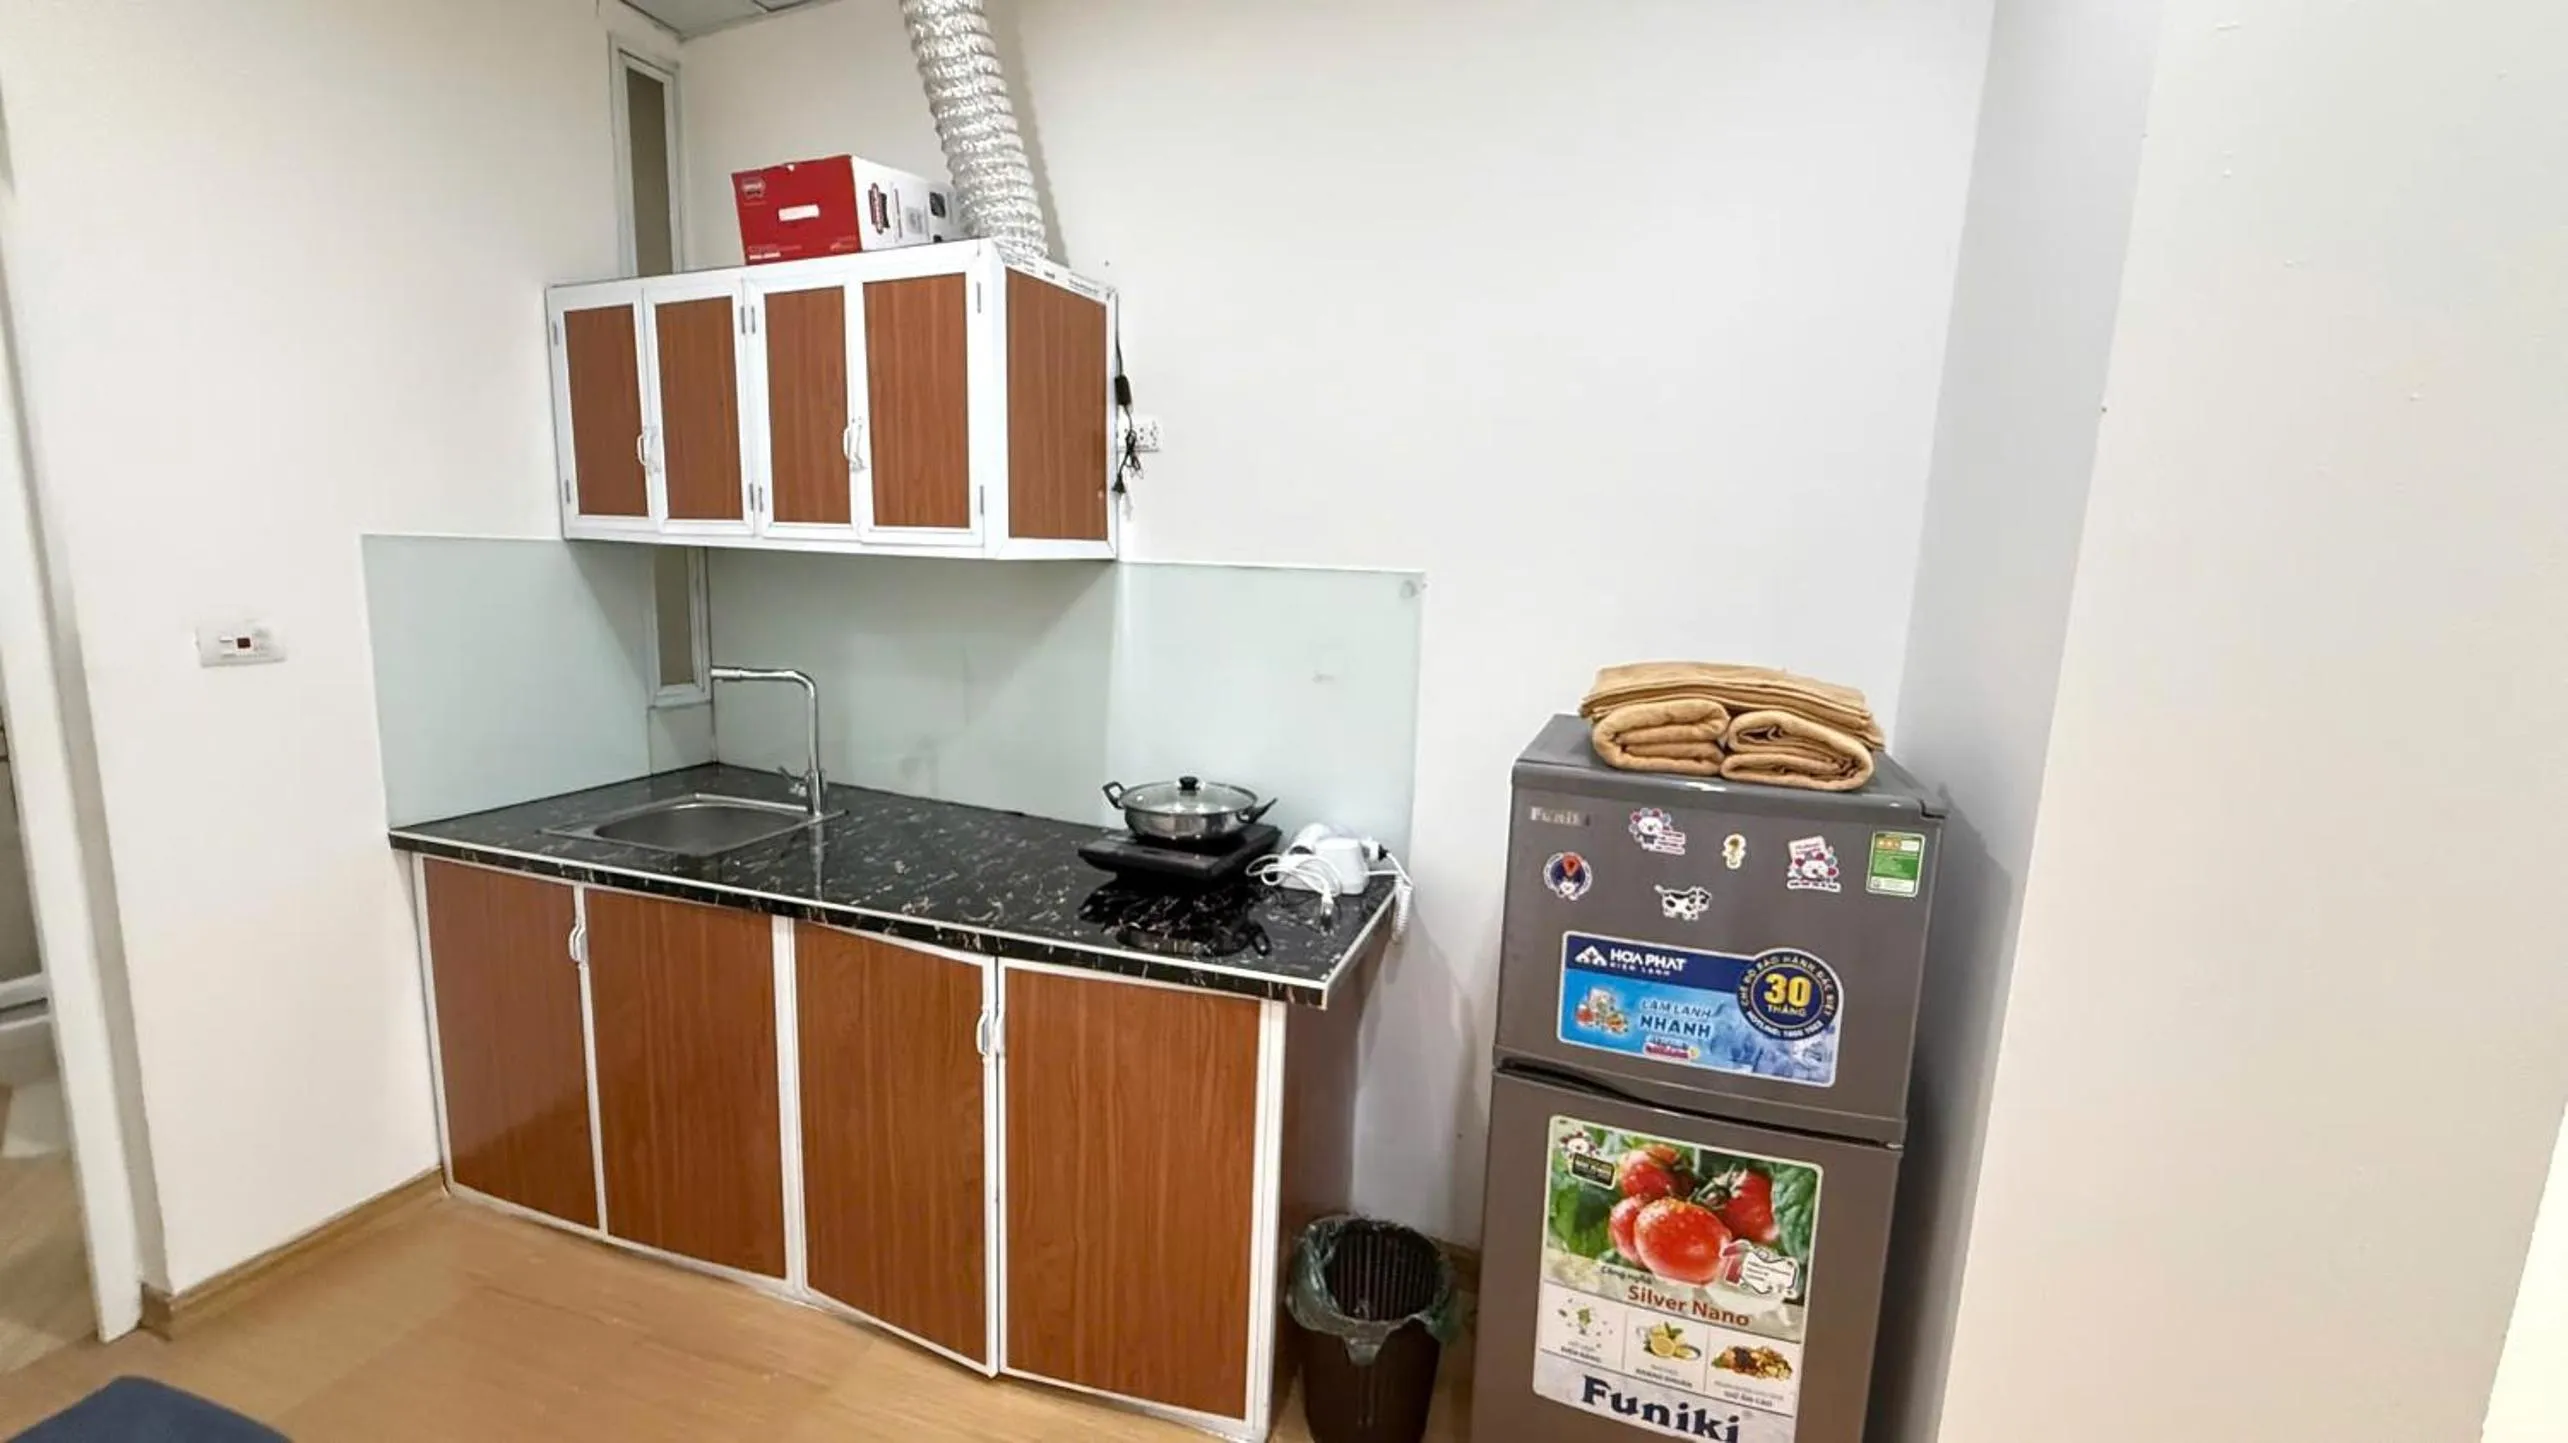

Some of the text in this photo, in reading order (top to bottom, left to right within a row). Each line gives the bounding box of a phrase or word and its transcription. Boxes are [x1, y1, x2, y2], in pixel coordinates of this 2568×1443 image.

[1763, 972, 1812, 1007] 30
[1640, 1014, 1712, 1038] NHANH
[1627, 1284, 1750, 1327] Silver Nano
[1581, 1375, 1740, 1443] Funiki
